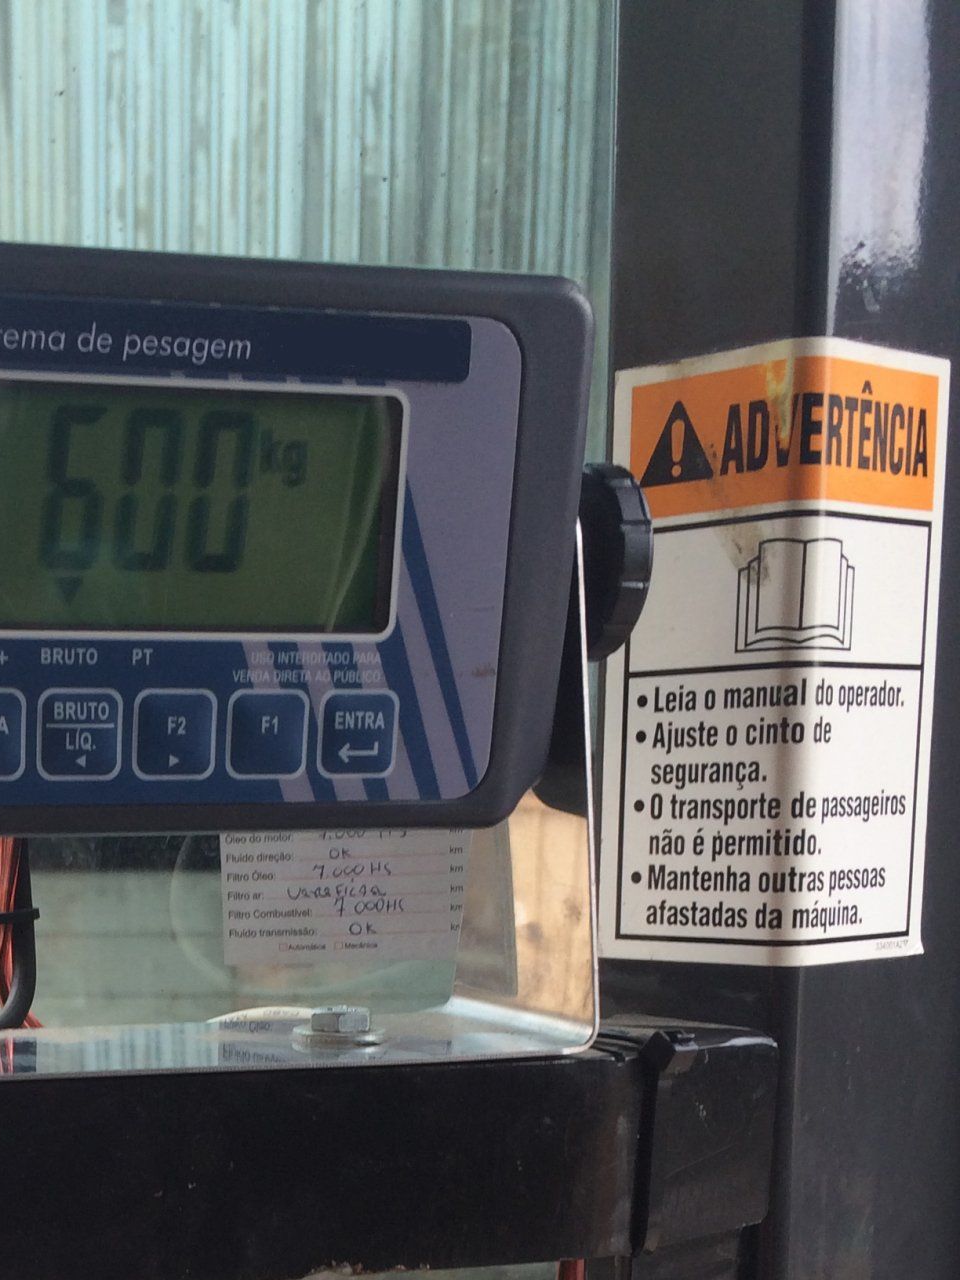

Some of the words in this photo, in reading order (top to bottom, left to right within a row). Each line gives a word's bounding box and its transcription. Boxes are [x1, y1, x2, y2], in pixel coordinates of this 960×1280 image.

[77, 321, 113, 354] de
[122, 333, 252, 366] pesagem
[719, 379, 929, 478] ADVERTÊNCIA
[39, 404, 257, 574] 600
[259, 428, 309, 488] kg
[40, 647, 98, 665] BRUTO
[131, 648, 154, 666] PT
[653, 684, 697, 713] Leia
[703, 691, 716, 710] o
[723, 677, 807, 710] manual
[815, 677, 833, 706] do
[838, 680, 905, 713] operador.
[53, 700, 110, 721] BRUTO
[334, 710, 386, 731] ENTRA
[65, 727, 97, 751] LÍQ.
[167, 715, 187, 736] F2
[261, 715, 280, 736] F1
[652, 721, 718, 754] Ajuste
[725, 727, 738, 747] o
[745, 717, 806, 746] cinto
[812, 715, 833, 743] de
[650, 760, 768, 791] segurança.
[650, 792, 663, 820] O
[670, 792, 782, 826] transporte
[790, 790, 817, 819] de
[821, 789, 907, 825] passageiros
[448, 845, 464, 854] km
[648, 828, 685, 856] não
[692, 827, 705, 856] é
[711, 828, 822, 862] permitido.
[449, 864, 464, 873] km
[646, 863, 751, 892] Mantenha
[757, 865, 825, 893] outras
[828, 866, 887, 897] pessoas
[449, 884, 465, 893] km
[645, 899, 749, 929] afastadas
[754, 901, 783, 930] da
[791, 899, 863, 934] máquina.
